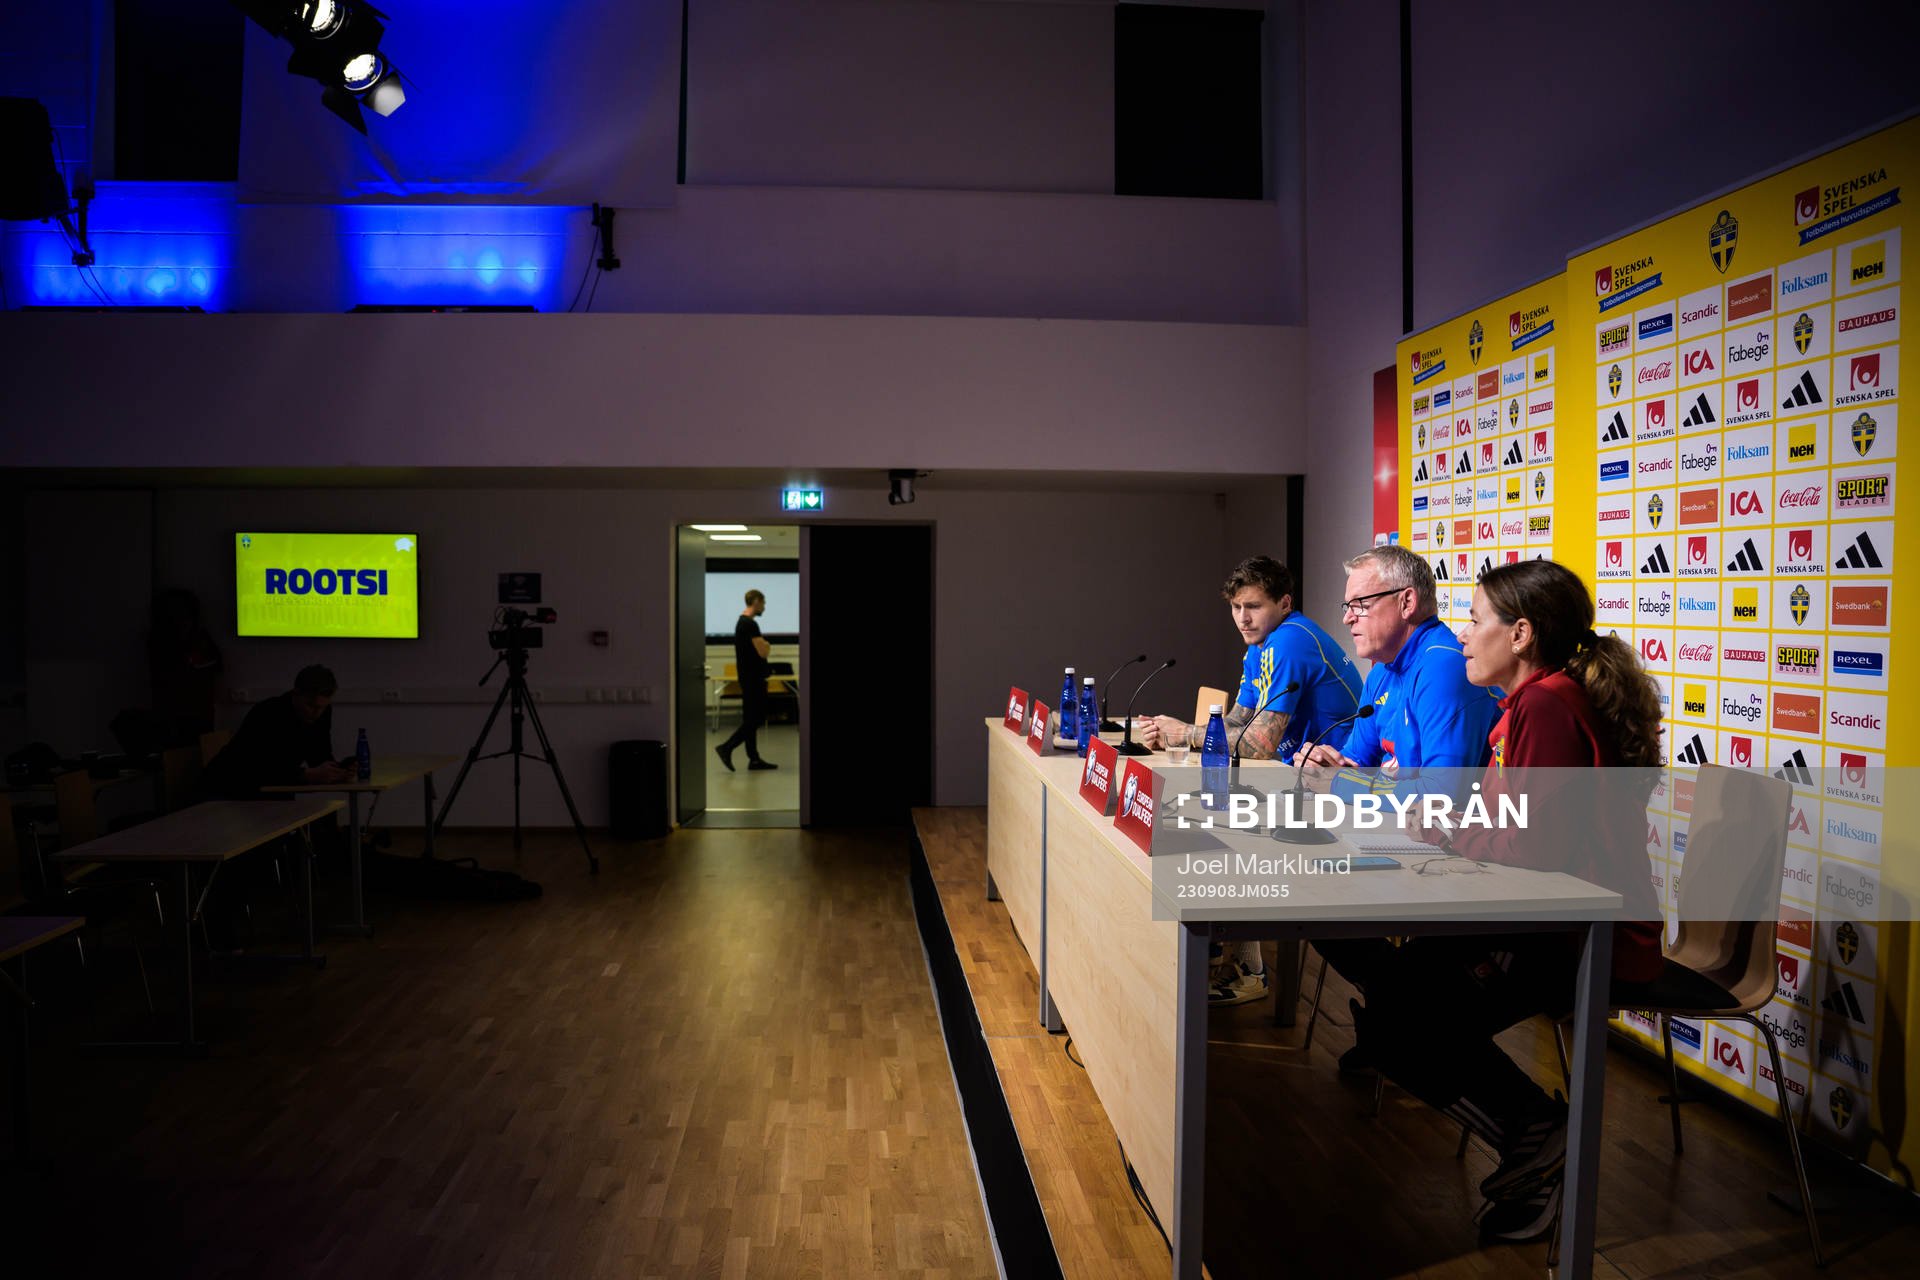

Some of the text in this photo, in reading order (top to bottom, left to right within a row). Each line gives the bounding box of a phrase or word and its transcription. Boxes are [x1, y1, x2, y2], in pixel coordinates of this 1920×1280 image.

[1824, 168, 1887, 201] SVENSKA
[1824, 195, 1856, 216] SPEL
[1615, 256, 1653, 279] SVENSKA
[1615, 275, 1634, 290] SPEL
[1782, 272, 1828, 295] Folksam
[1730, 293, 1760, 307] Swedbank
[1522, 305, 1549, 322] SVENSKA
[1681, 304, 1718, 324] Scandic
[1839, 309, 1896, 331] BAUHAUS
[1522, 320, 1536, 333] SPEL
[1600, 325, 1629, 347] SPORT
[1729, 343, 1769, 363] Fabege
[1684, 348, 1715, 377] ICA
[1836, 389, 1896, 405] SVENSKA SPEL
[1726, 411, 1771, 425] SVENSKA SPEL
[1457, 418, 1471, 437] ICA
[1637, 429, 1675, 440] SVENSKA SPEL
[1727, 445, 1769, 460] Folksam
[1638, 458, 1673, 473] Scandic
[1681, 454, 1717, 471] Fabege
[1838, 477, 1888, 500] SPORT
[1681, 504, 1707, 512] Swedbank
[1730, 490, 1764, 516] ICA
[1840, 498, 1885, 507] BLADET
[1529, 516, 1550, 531] SPORT
[1599, 510, 1630, 520] BAUHAUS
[1478, 522, 1494, 540] ICA
[1678, 567, 1718, 576] SVENSKA SPEL
[1776, 565, 1825, 573] SVENSKA SPEL
[265, 568, 388, 596] ROOTSI
[1598, 598, 1629, 609] Scandic
[1639, 597, 1670, 616] Fabege
[1679, 597, 1716, 611] Folksam
[1835, 601, 1871, 610] Swedbank
[1641, 639, 1667, 662] ICA
[1724, 649, 1765, 661] BAUHAUS
[1778, 647, 1819, 666] SPORT
[1722, 698, 1761, 722] Fabege
[1776, 707, 1807, 718] Swedbank
[1830, 711, 1881, 730] Scandic
[1826, 786, 1881, 804] SVENSKA SPEL
[1826, 819, 1877, 845] Folksam
[1825, 875, 1873, 907] Fabege
[1713, 1038, 1745, 1075] ICA
